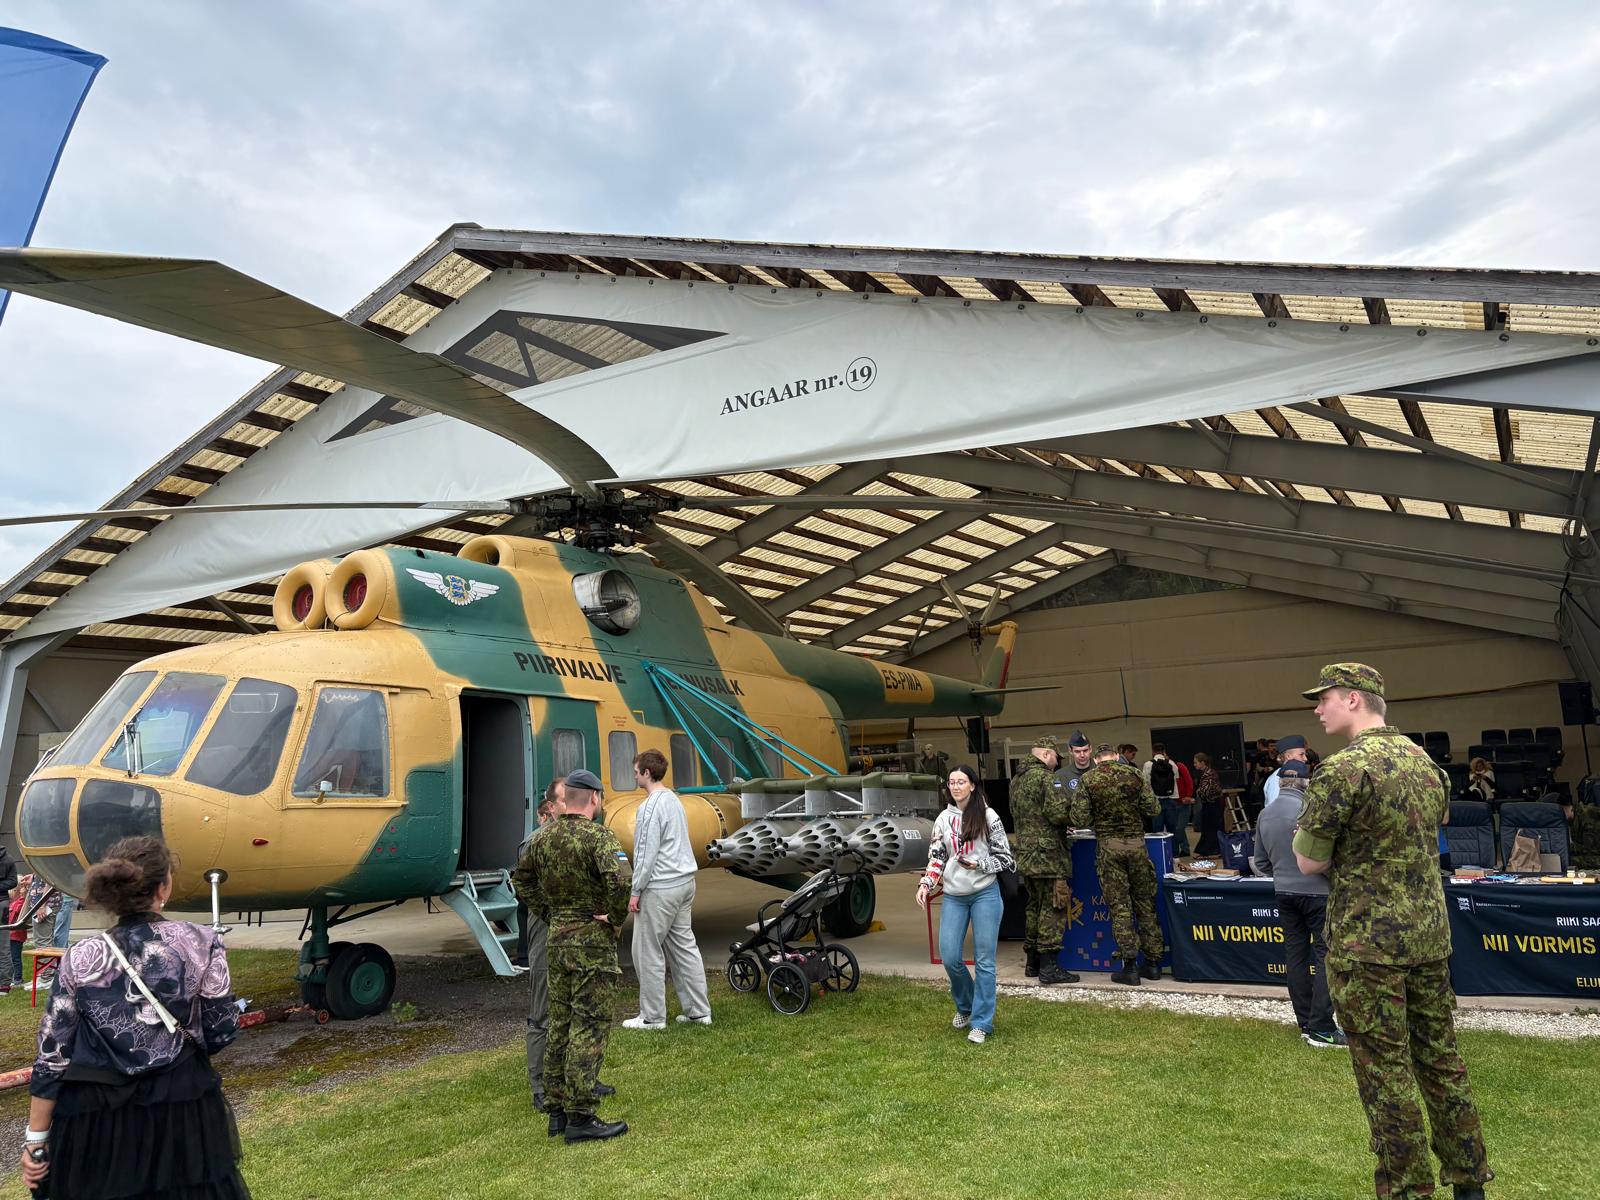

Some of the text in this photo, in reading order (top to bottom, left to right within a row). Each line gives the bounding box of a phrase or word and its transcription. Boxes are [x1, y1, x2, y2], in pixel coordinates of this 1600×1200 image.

[719, 365, 873, 416] ANGAAR nr. 19
[512, 652, 627, 685] PIIRIVALVE
[881, 669, 923, 691] ES-PMA
[1091, 895, 1106, 906] KA
[1252, 908, 1271, 917] RIIKI
[1556, 916, 1580, 926] RIIKI
[1192, 925, 1285, 943] NII VORMIS
[1482, 934, 1597, 954] NII VORMIS
